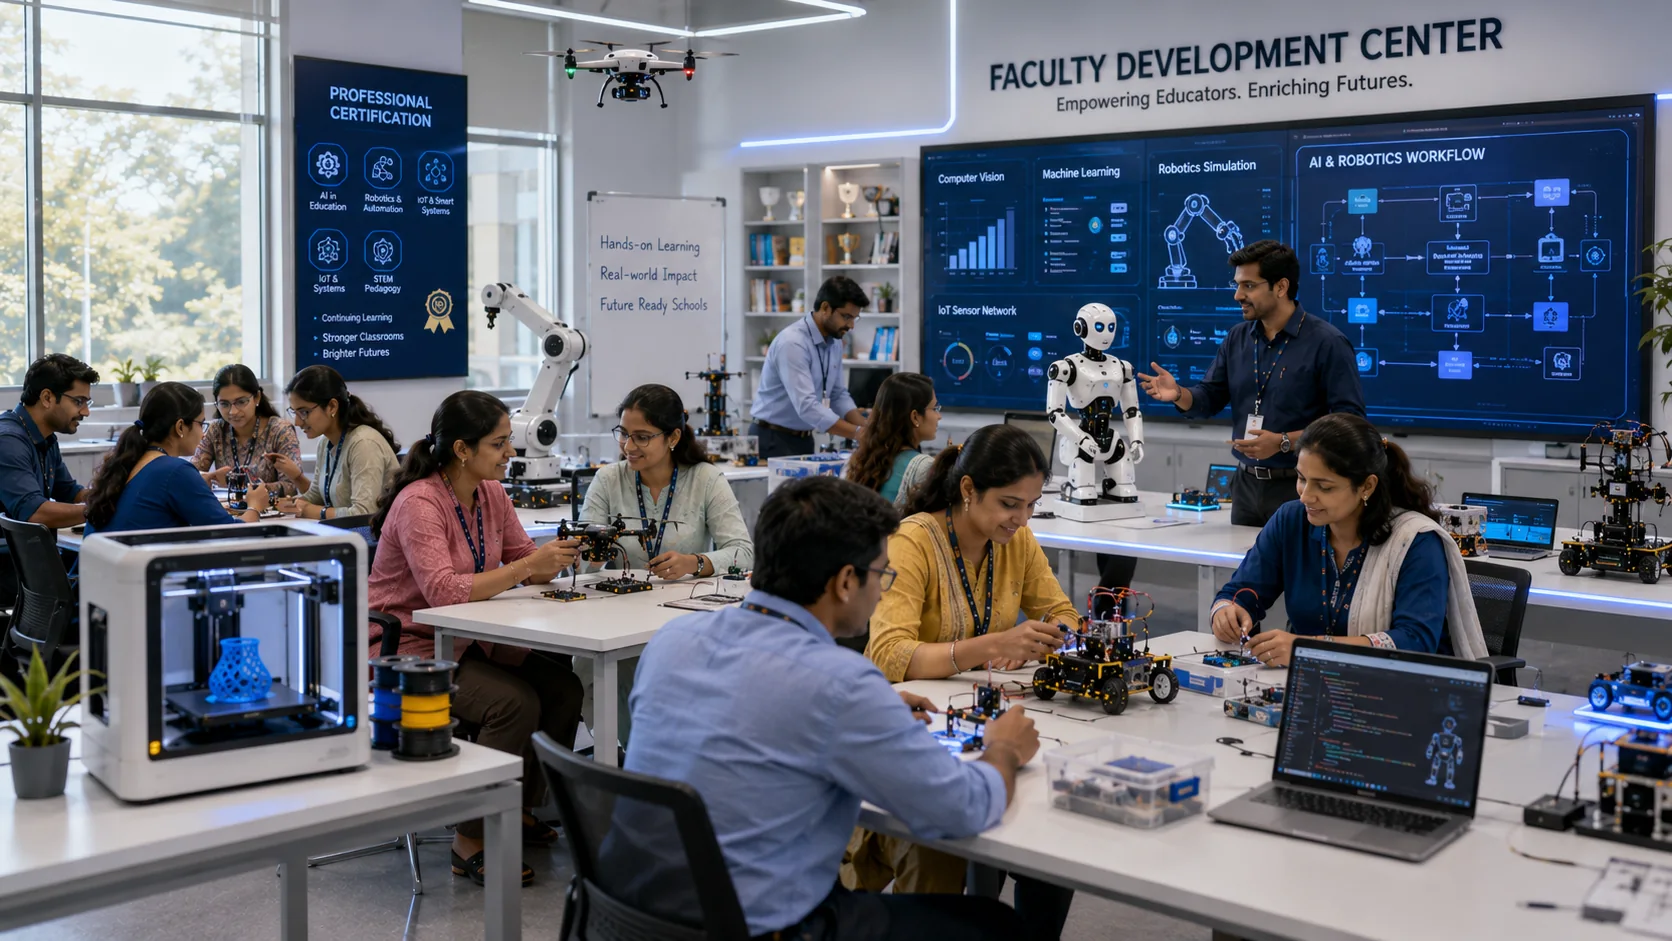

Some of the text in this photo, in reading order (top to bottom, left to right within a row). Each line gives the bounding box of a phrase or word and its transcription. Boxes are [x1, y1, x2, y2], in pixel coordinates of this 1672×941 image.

[990, 17, 1503, 91] FACULTY DEVELOPMENT CENTER
[330, 86, 433, 110] PROFESSIONAL
[1057, 74, 1413, 114] Empowering Educators. Enriching Futures.
[330, 105, 432, 128] CERTIFICATION
[1309, 147, 1486, 168] AI & ROBOTICS WORKFLOW
[1042, 165, 1120, 179] Machine Learning
[1158, 159, 1257, 174] Robotics Simulation
[938, 171, 1005, 185] Computer Vision
[320, 191, 337, 200] AI in
[364, 193, 402, 203] Robotics &
[435, 196, 454, 205] Smart
[309, 201, 347, 211] Education
[363, 204, 404, 213] Automation
[421, 206, 450, 216] Systems
[600, 235, 700, 258] Hands-on Learning
[332, 275, 338, 283] &
[373, 275, 394, 283] STEM
[600, 265, 698, 286] Real-world Impact
[313, 284, 346, 294] Systems
[364, 284, 401, 294] Pedagogy
[600, 297, 708, 316] Future Ready Schools
[938, 305, 1017, 316] IoT Sensor Network
[321, 313, 393, 324] Continuing Learning
[322, 332, 405, 345] Stronger Classrooms
[322, 348, 390, 361] Brighter Futures
